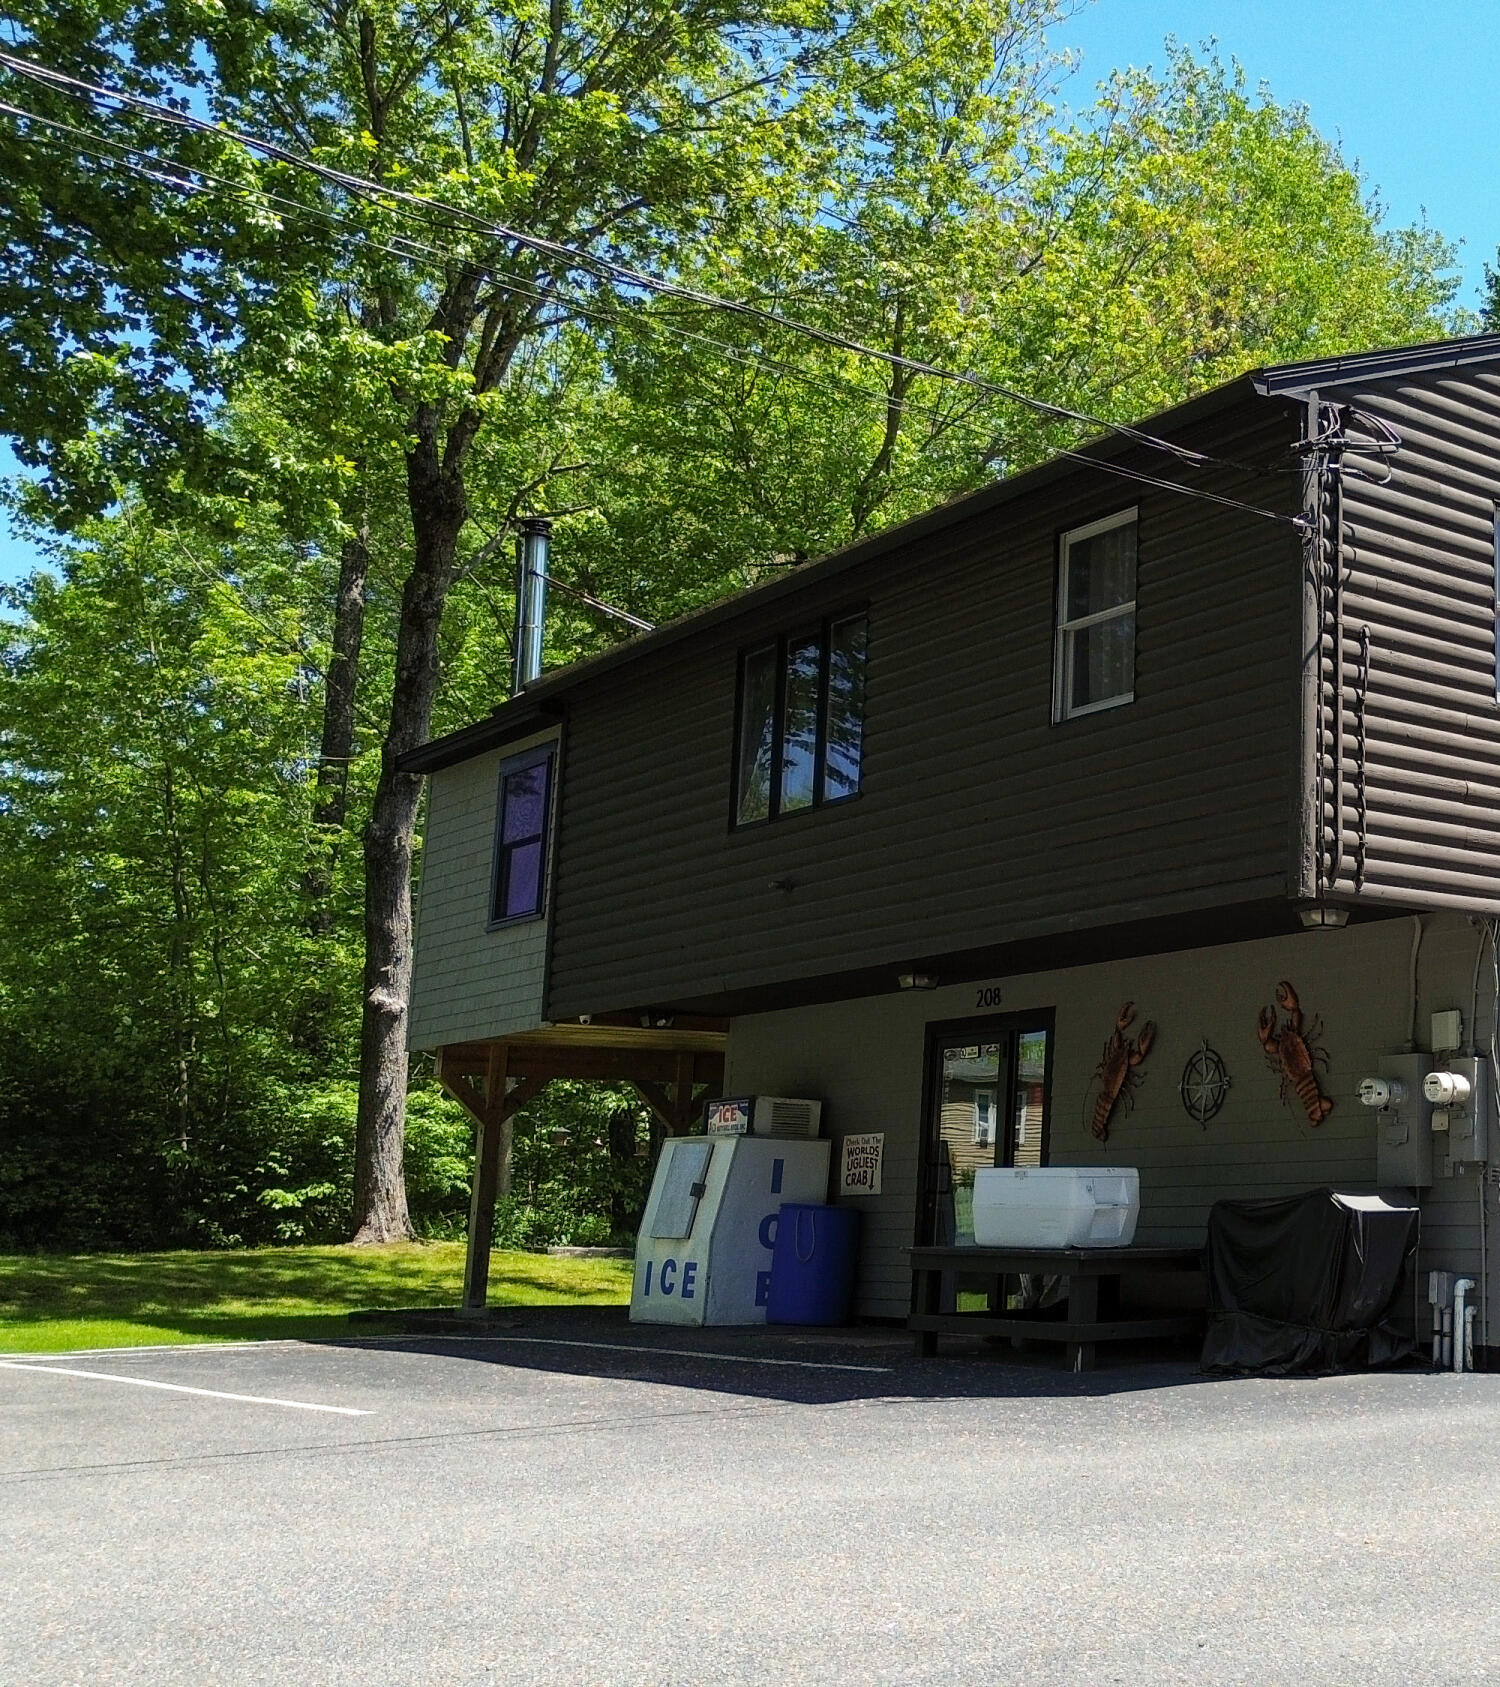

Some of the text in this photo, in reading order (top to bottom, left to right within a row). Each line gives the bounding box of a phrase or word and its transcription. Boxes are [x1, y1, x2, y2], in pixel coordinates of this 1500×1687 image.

[976, 987, 1001, 1008] 208
[718, 1105, 739, 1124] ICE
[847, 1146, 880, 1159] WORLDS
[847, 1156, 879, 1171] UGLIEST
[845, 1170, 868, 1186] CRAB
[644, 1258, 698, 1299] ICE
